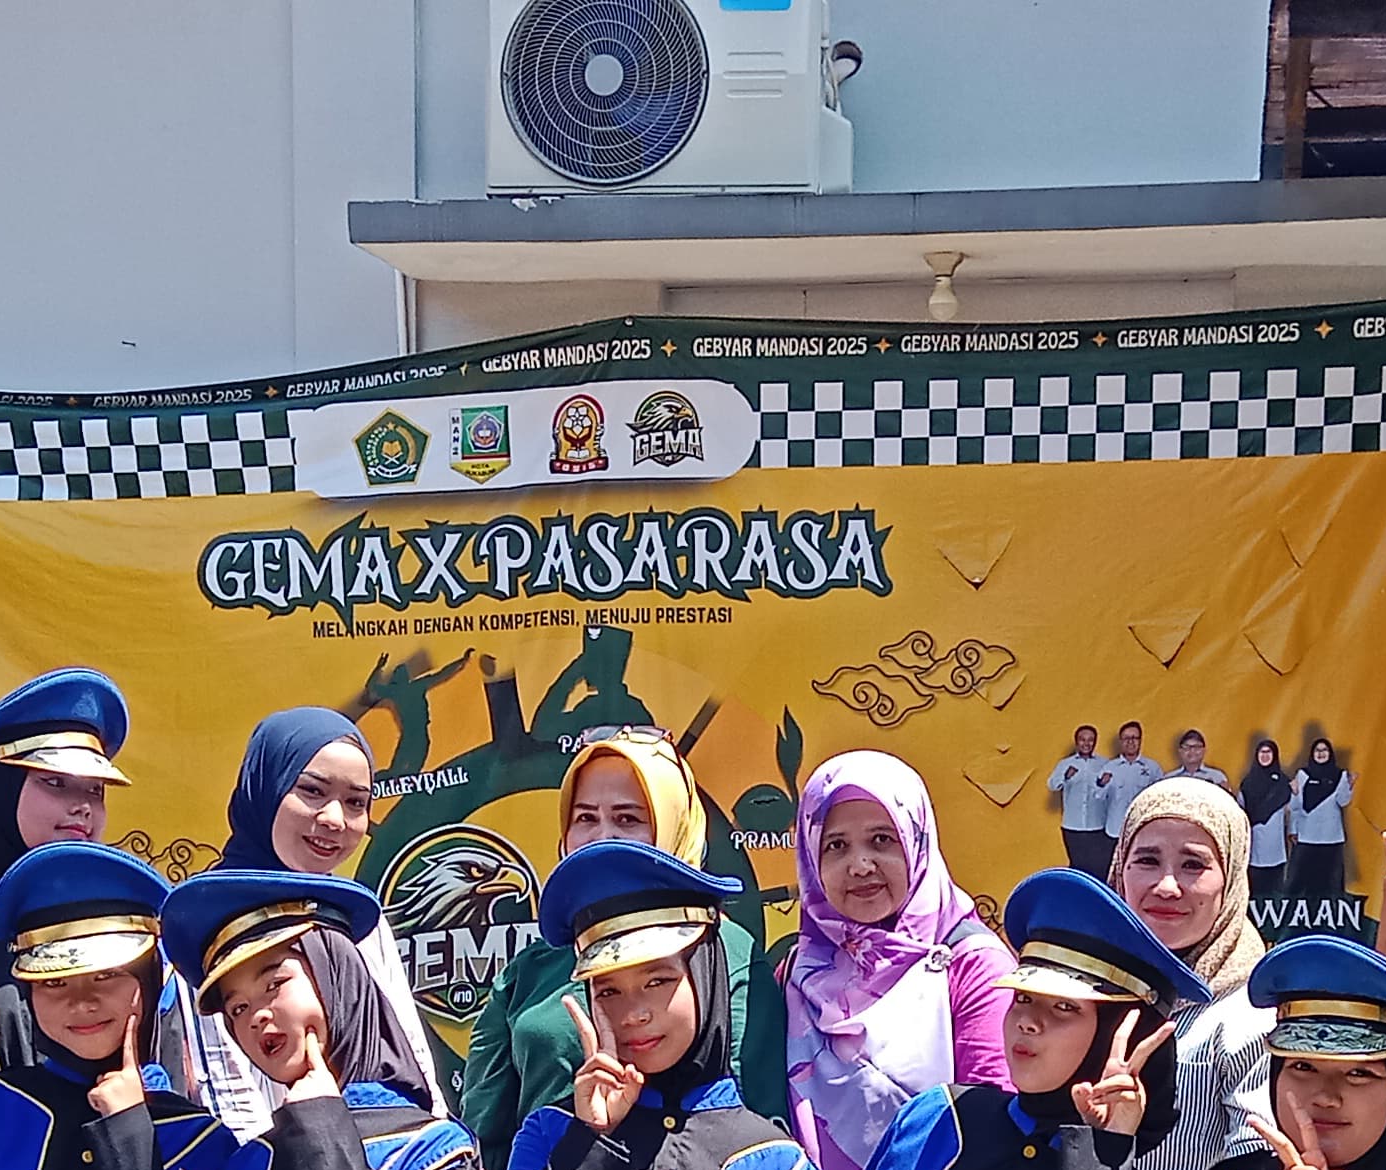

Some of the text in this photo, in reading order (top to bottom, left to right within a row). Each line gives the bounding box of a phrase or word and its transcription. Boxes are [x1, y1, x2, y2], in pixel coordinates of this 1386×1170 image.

[693, 336, 867, 358] GEBYAR MANDASI 2025
[900, 330, 1079, 353] GEBYAR MANDASI 2025
[1117, 322, 1300, 348] GEBYAR MANDASI 2025
[482, 339, 651, 373] GEBYAR MANDASI 2025
[286, 379, 340, 398] GEBYAR
[635, 429, 704, 466] GEMA
[205, 514, 878, 608] GEMA X PASARASA
[313, 606, 733, 638] MELANGKAH DENGAN KOMPETENSI, MENUJU PRESTASI
